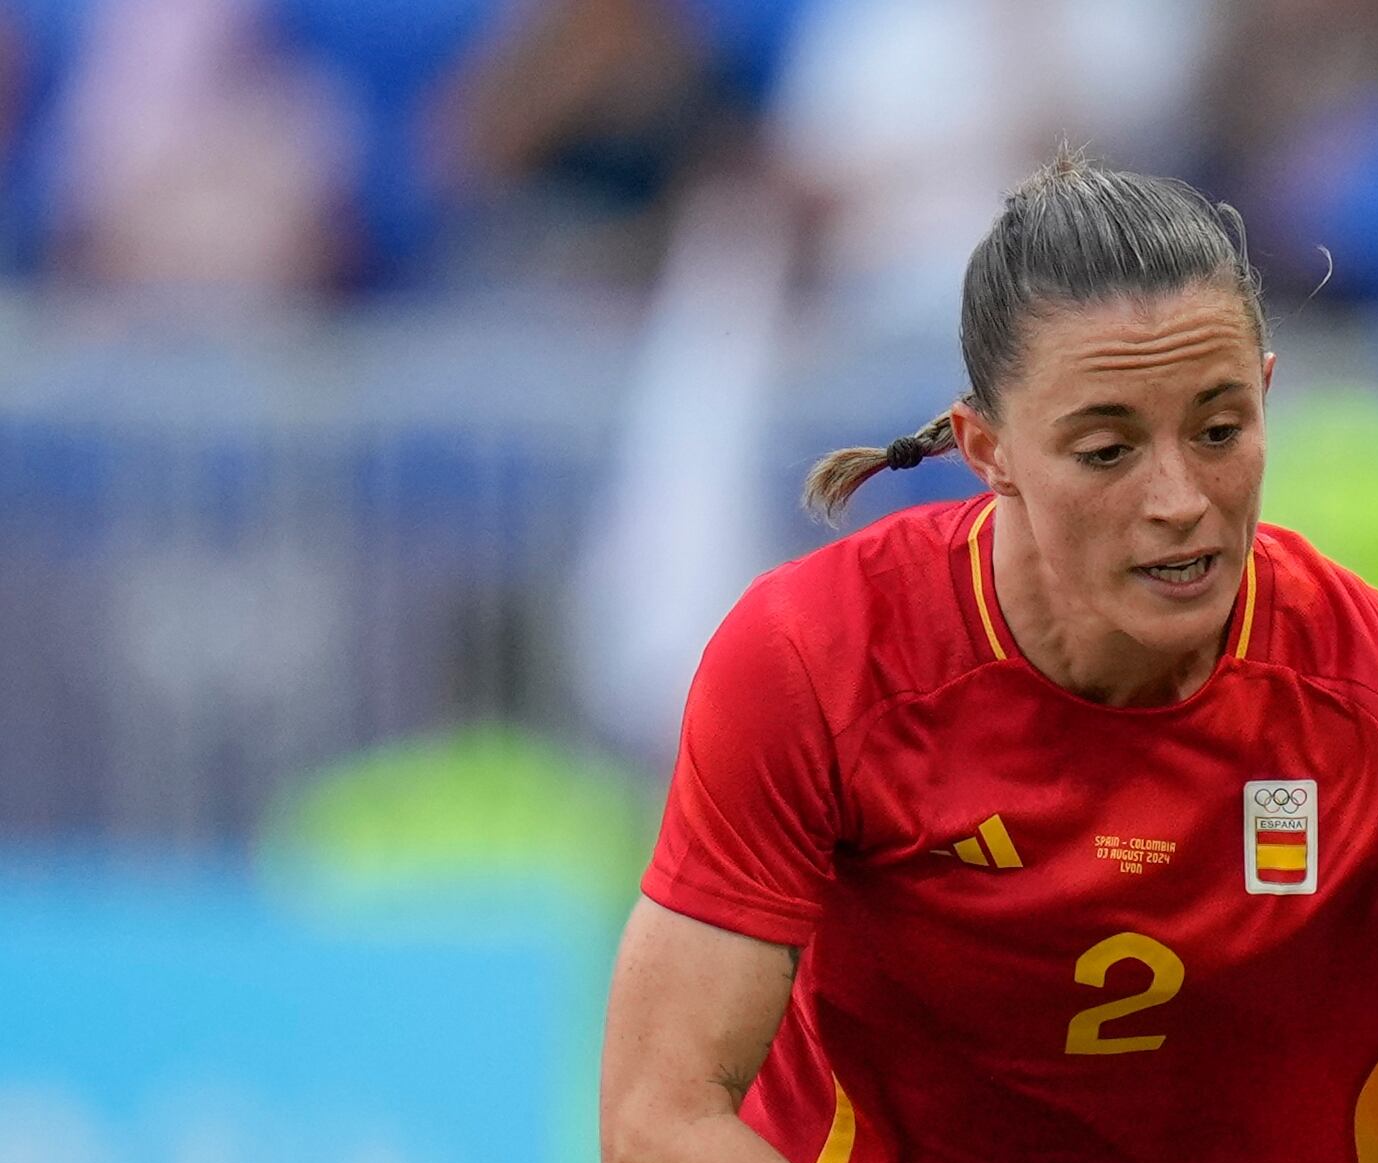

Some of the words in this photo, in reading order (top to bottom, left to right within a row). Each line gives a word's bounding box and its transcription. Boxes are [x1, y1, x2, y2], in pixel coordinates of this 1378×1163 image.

[1260, 819, 1303, 829] ESPAÑA
[1095, 835, 1120, 847] SPAIN
[1129, 837, 1176, 853] COLOMBIA
[1097, 848, 1108, 858] 03
[1110, 848, 1144, 862] AUGUST
[1146, 852, 1170, 864] 2024
[1120, 861, 1142, 874] LYON
[1065, 932, 1185, 1055] 2
